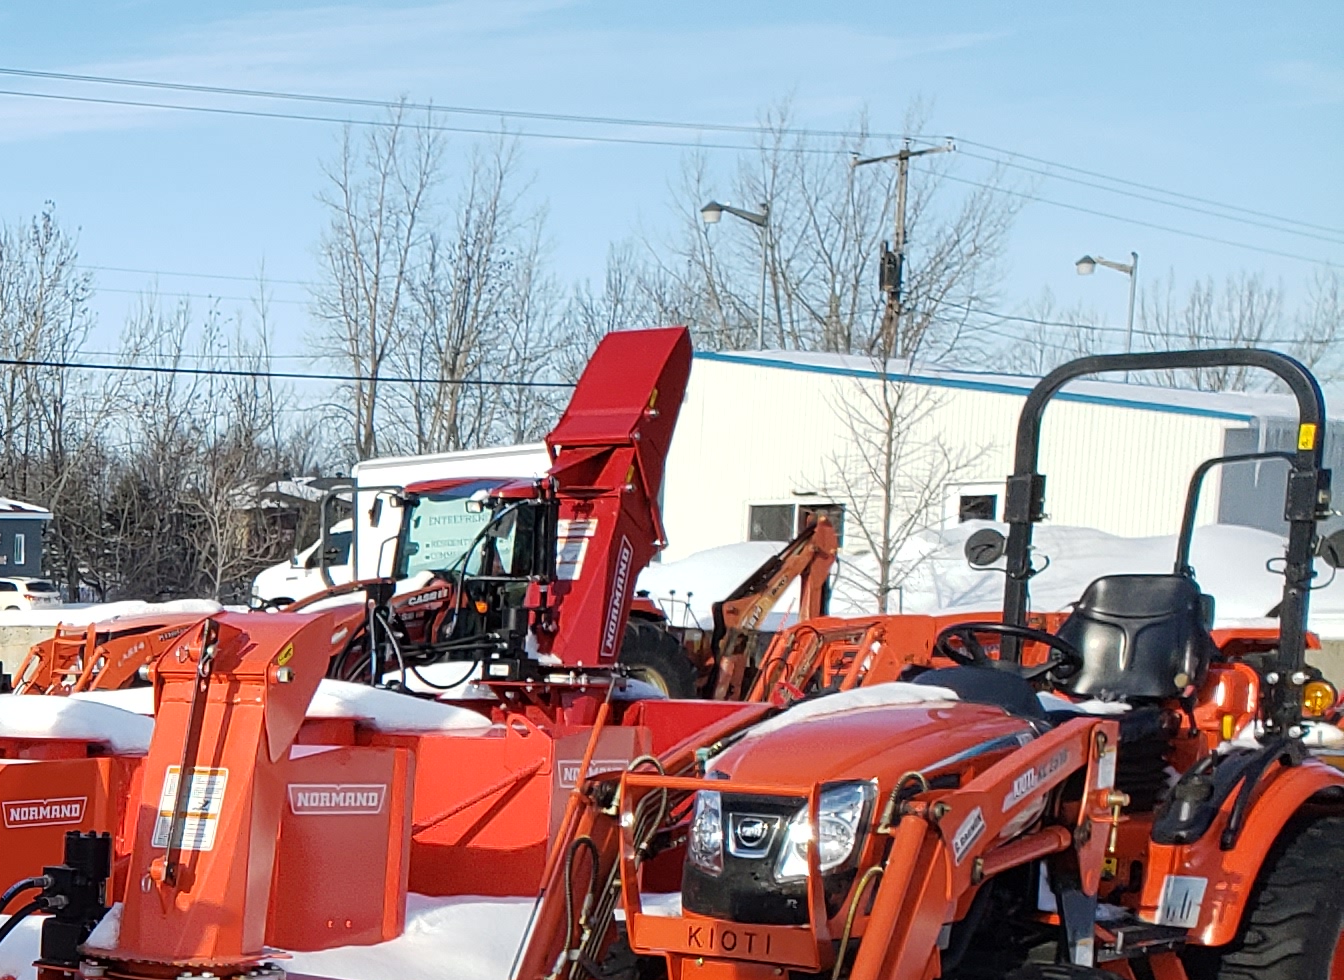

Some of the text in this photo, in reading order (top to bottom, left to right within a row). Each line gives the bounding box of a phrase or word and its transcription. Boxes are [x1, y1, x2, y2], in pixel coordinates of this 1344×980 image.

[605, 547, 630, 649] NORMAND
[297, 792, 379, 807] NORMAND
[9, 803, 81, 822] NORMAND
[687, 925, 771, 955] KIOTI
